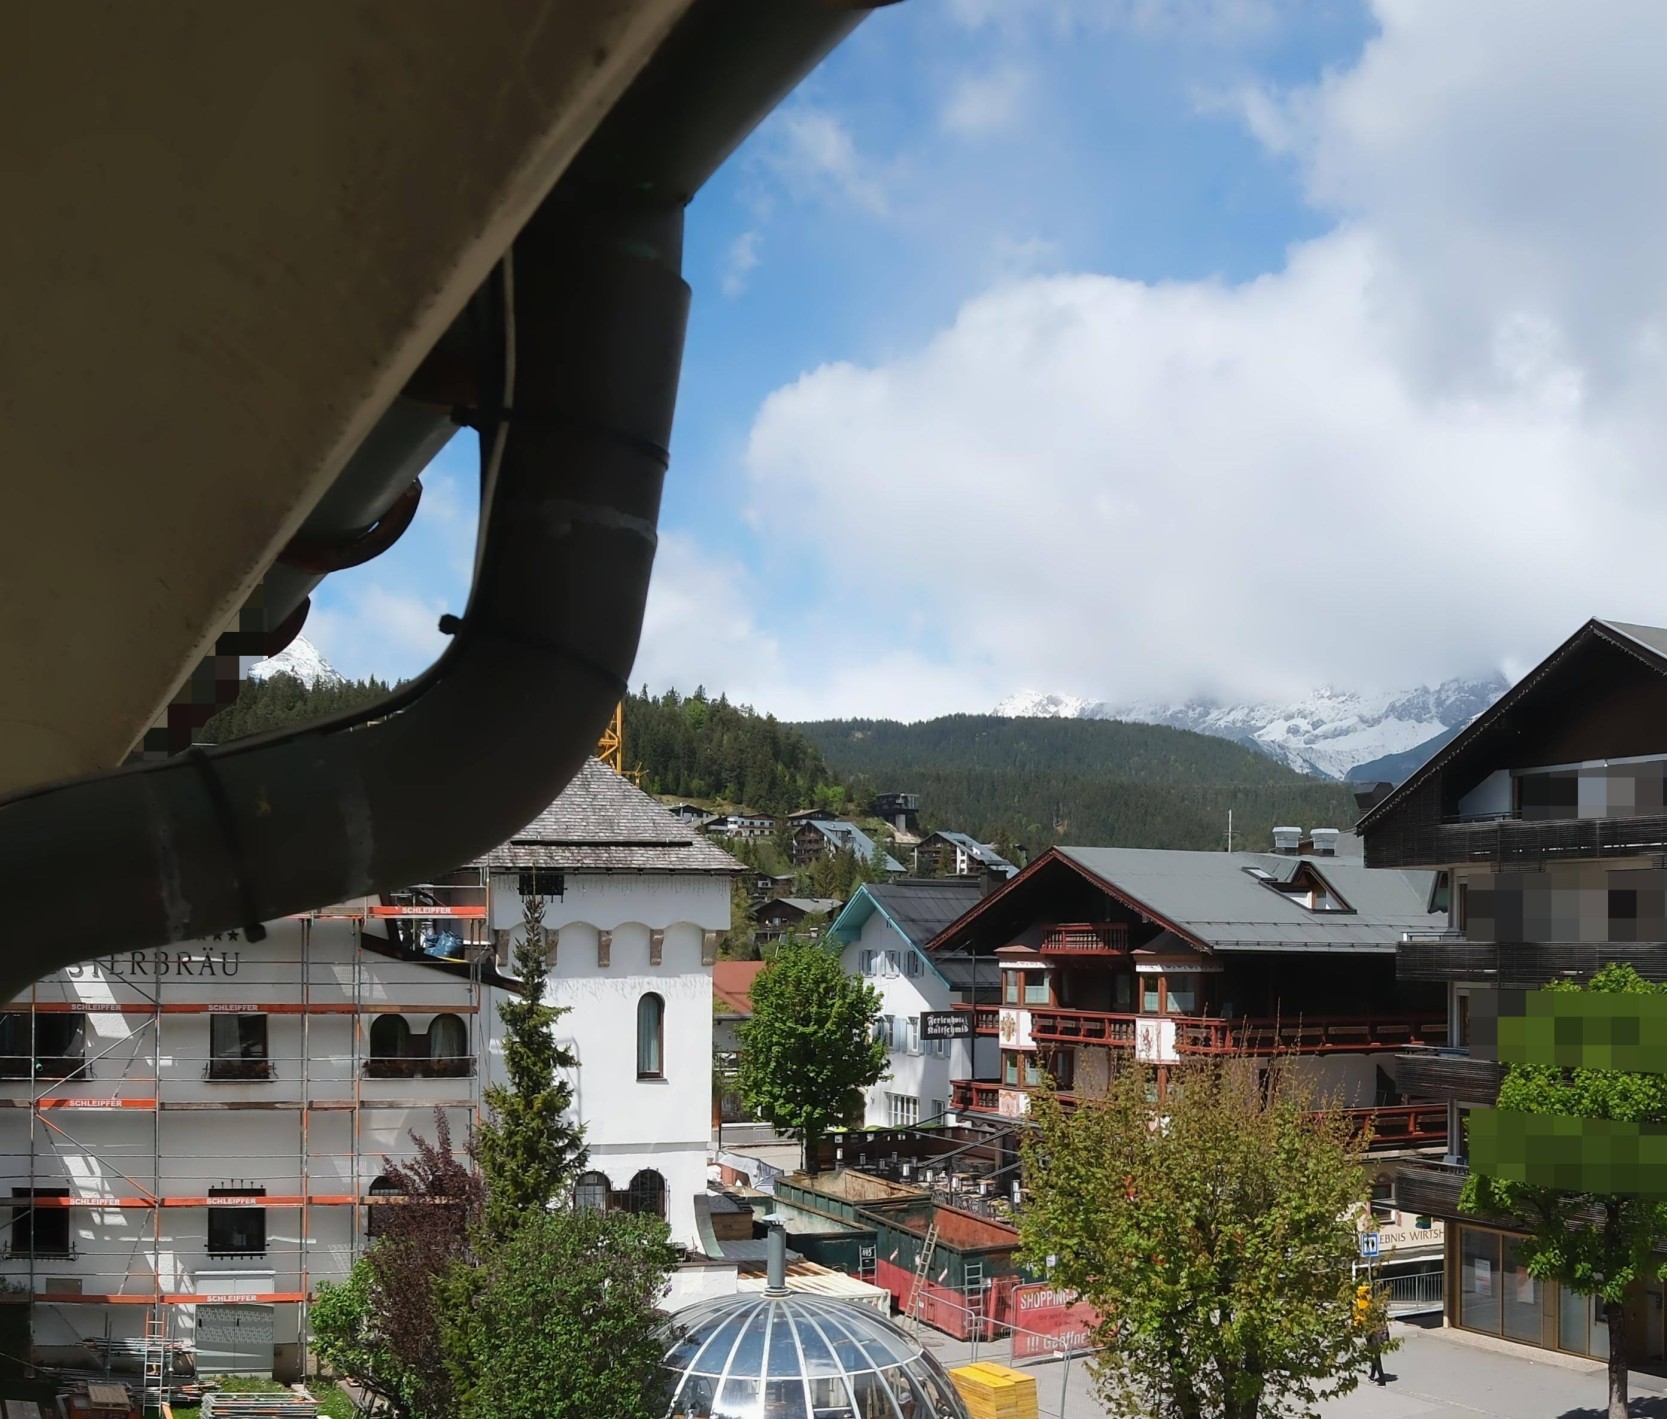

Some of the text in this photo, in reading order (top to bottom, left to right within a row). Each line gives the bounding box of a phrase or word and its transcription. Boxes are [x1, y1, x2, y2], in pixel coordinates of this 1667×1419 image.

[401, 906, 452, 915] SCHLEIPFER
[71, 1003, 122, 1011] SCHLEIPFER
[208, 1003, 258, 1011] SCHLEIPFER
[69, 1099, 122, 1107] SCHLEIPFER
[69, 1198, 120, 1206] SCHLEIPFER
[206, 1197, 257, 1205] SCHLEIPFER
[1379, 1232, 1406, 1245] EBNIS
[206, 1294, 257, 1302] SCHLEIPFER
